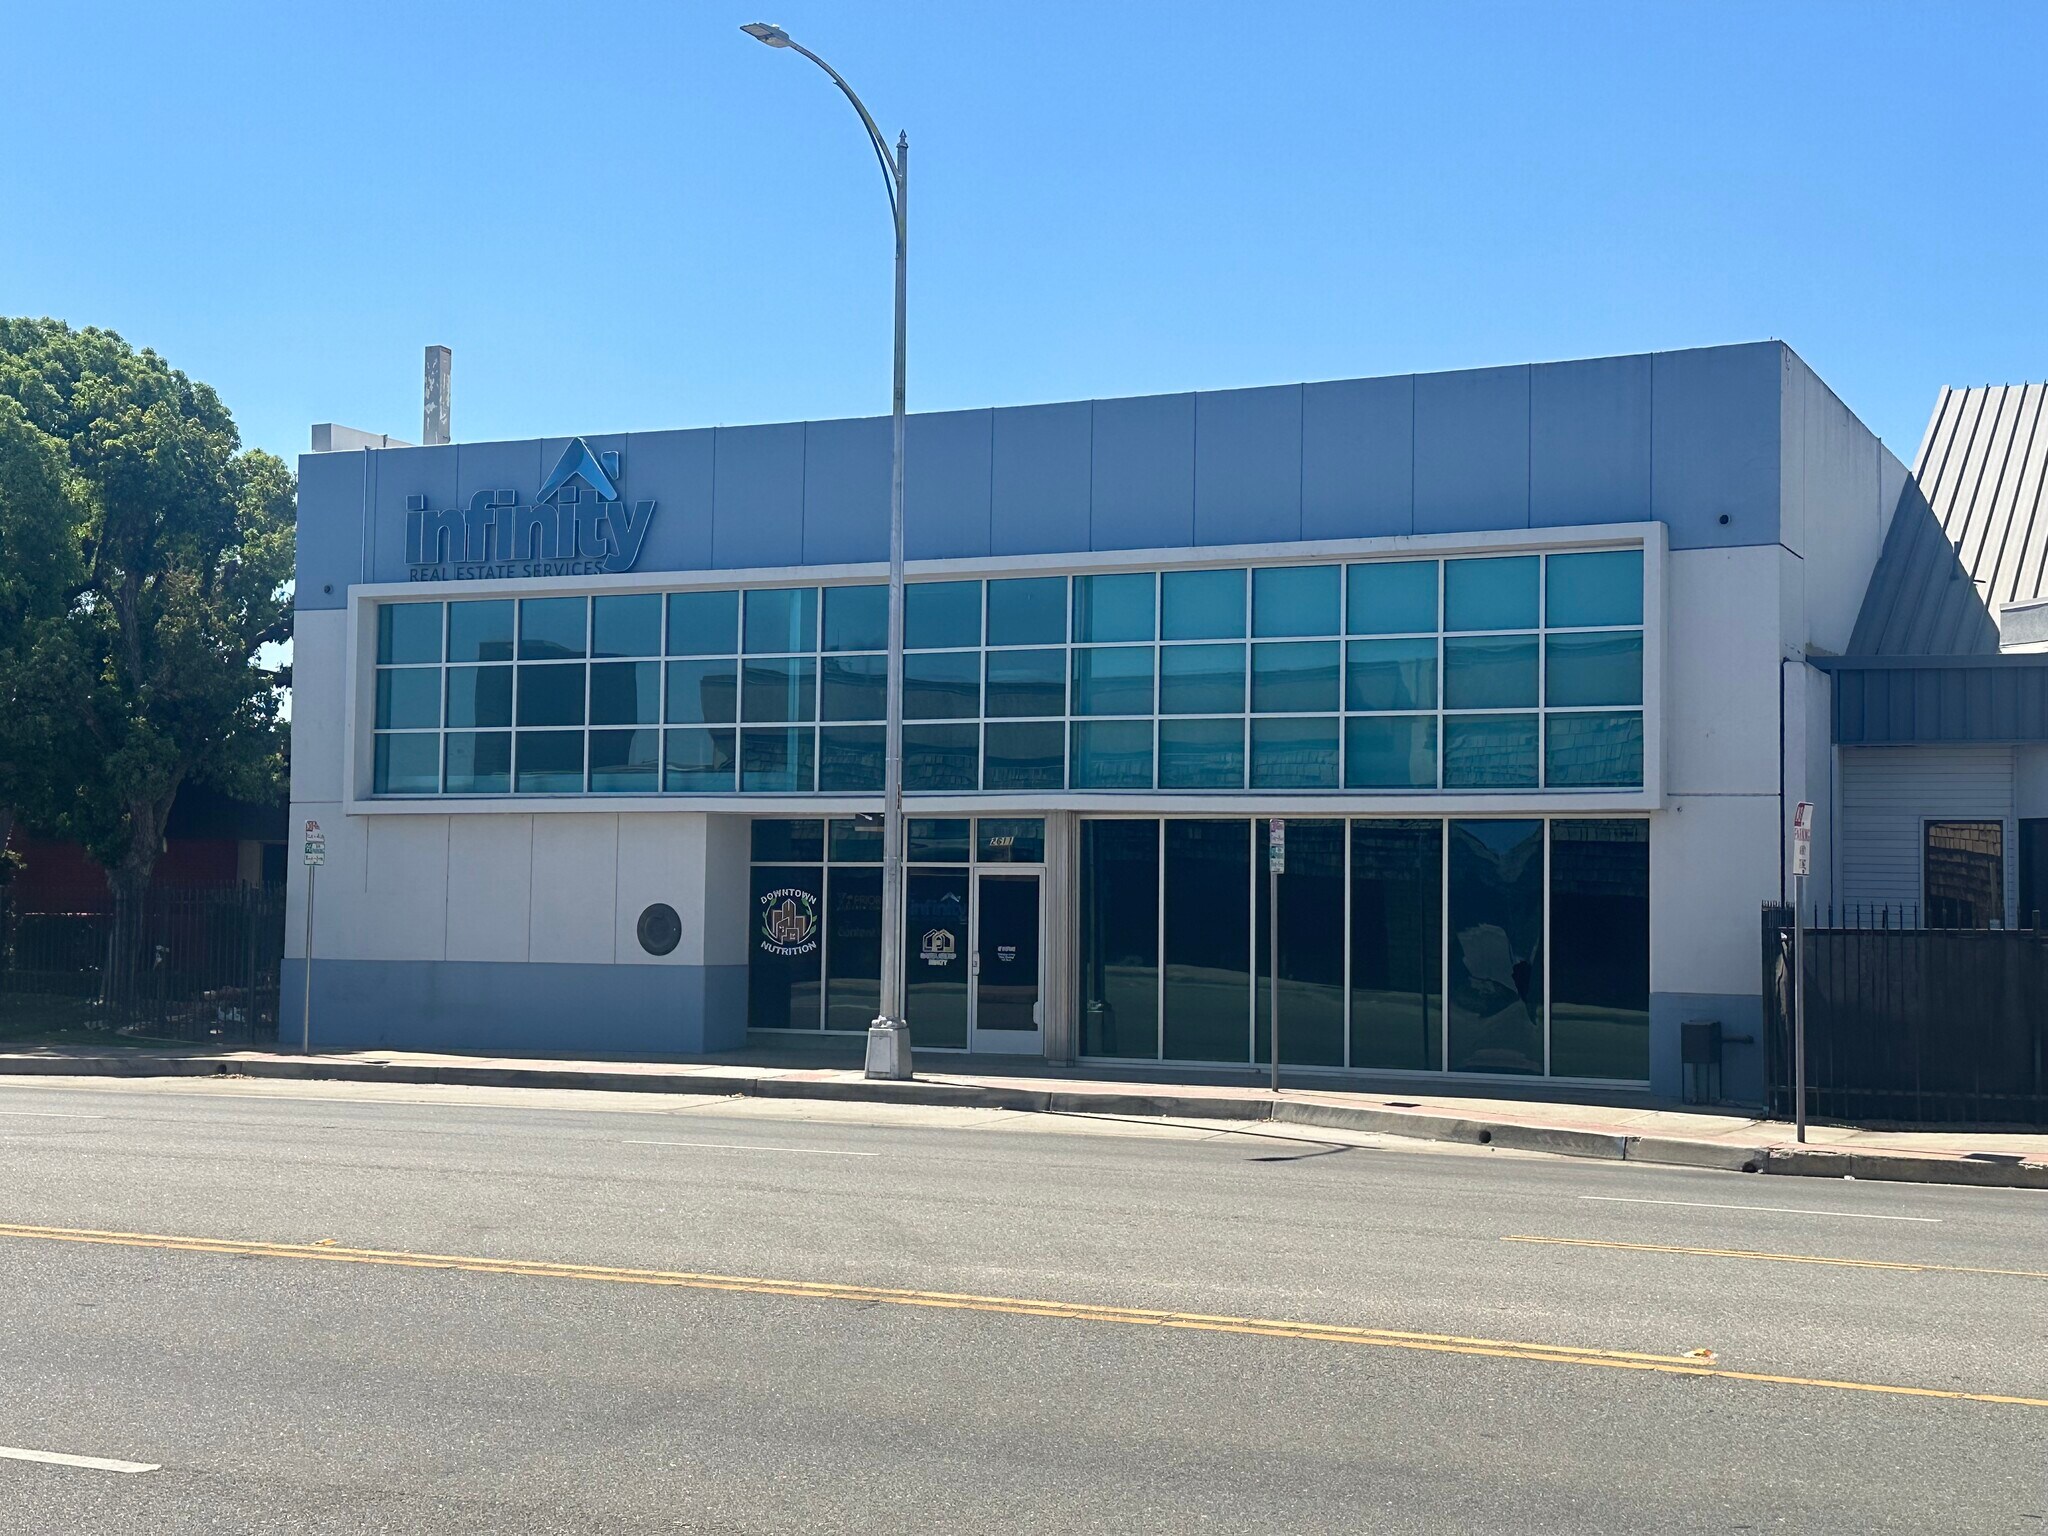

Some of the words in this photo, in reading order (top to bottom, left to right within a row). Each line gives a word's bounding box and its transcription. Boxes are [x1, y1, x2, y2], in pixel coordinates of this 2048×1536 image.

[404, 486, 656, 573] infinity
[409, 567, 449, 583] REAL
[457, 564, 516, 581] ESTATE
[523, 561, 603, 578] SERVICES
[760, 888, 817, 905] DOWNTOWN
[760, 940, 817, 956] NUTRITION
